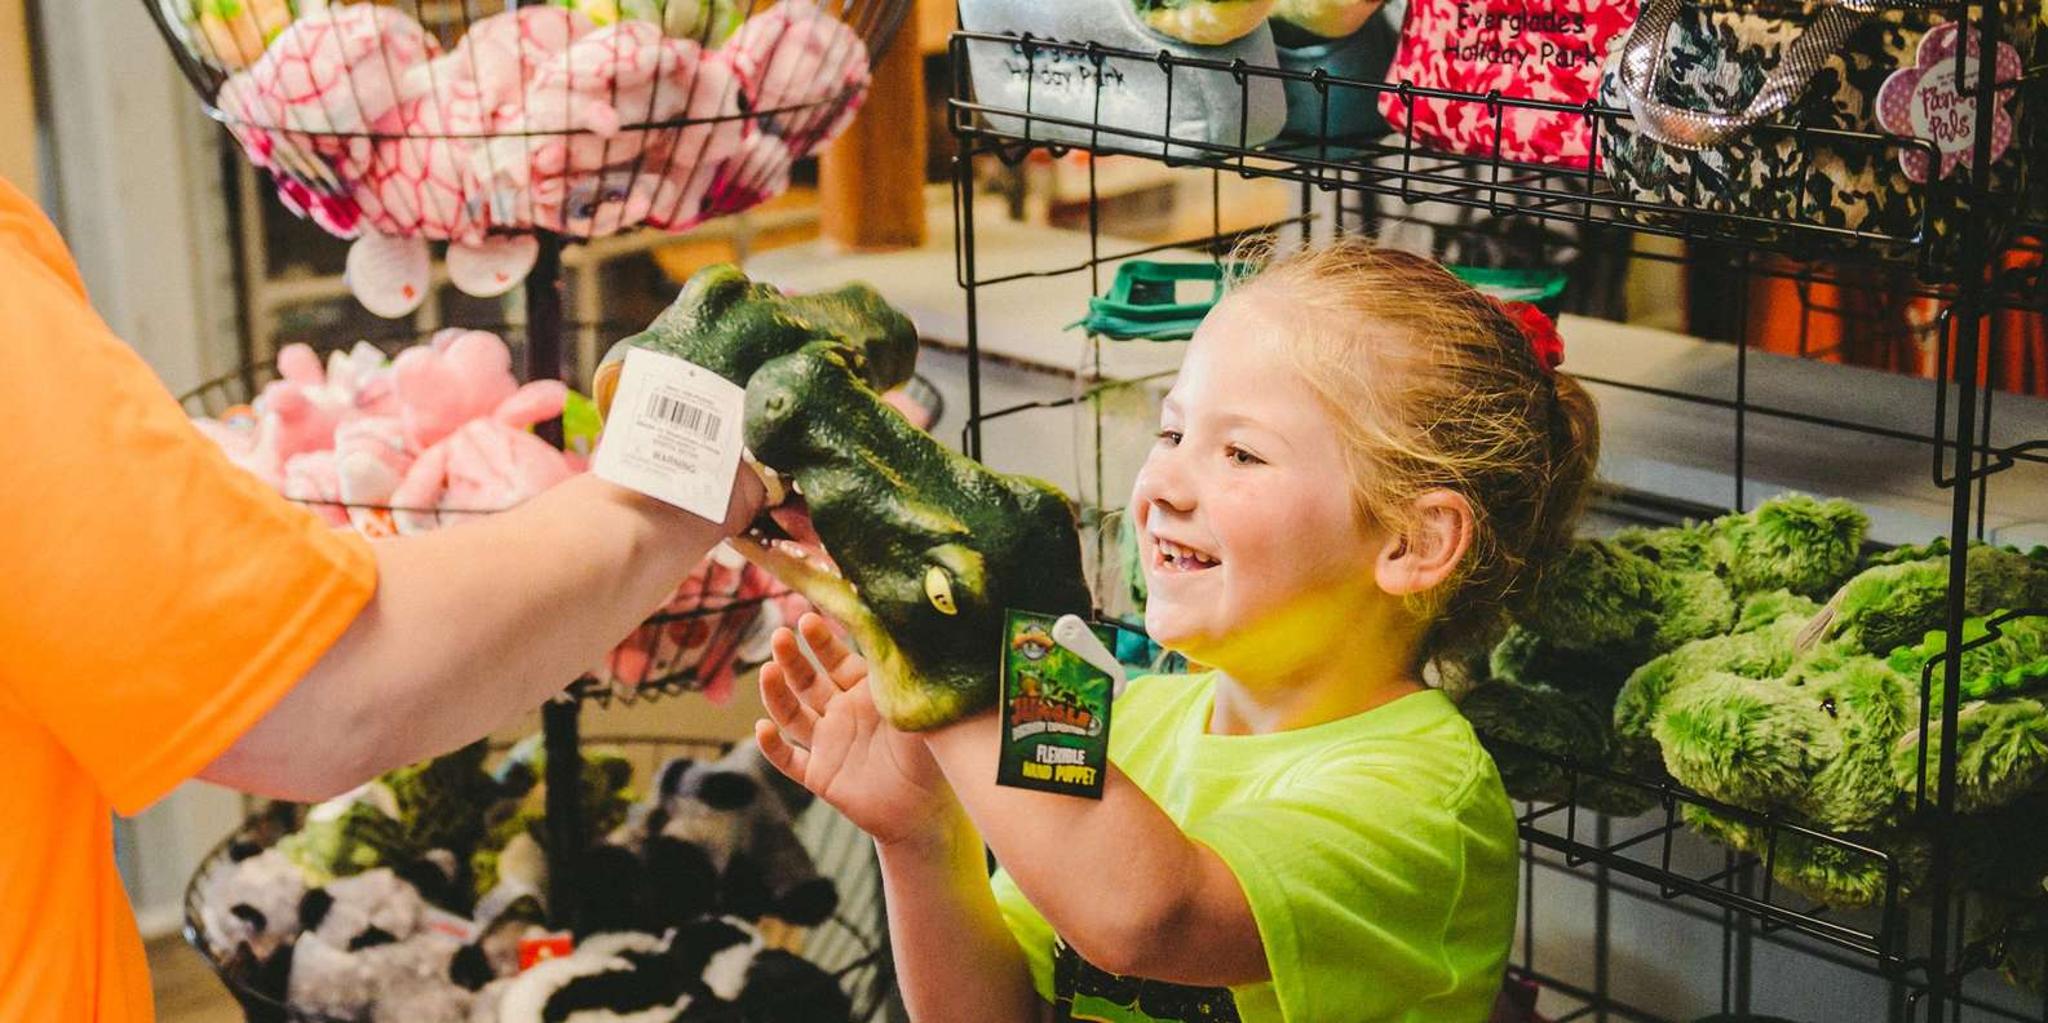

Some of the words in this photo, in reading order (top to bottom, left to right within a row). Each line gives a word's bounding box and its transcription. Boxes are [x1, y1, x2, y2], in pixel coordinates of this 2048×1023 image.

[1457, 3, 1586, 38] Everglades
[1443, 38, 1529, 71] Holiday
[1540, 41, 1598, 69] Park
[1079, 65, 1124, 87] Prk
[1928, 109, 1971, 144] Pals
[1036, 744, 1086, 765] FLEXIBLE
[1055, 764, 1097, 786] PUPPET
